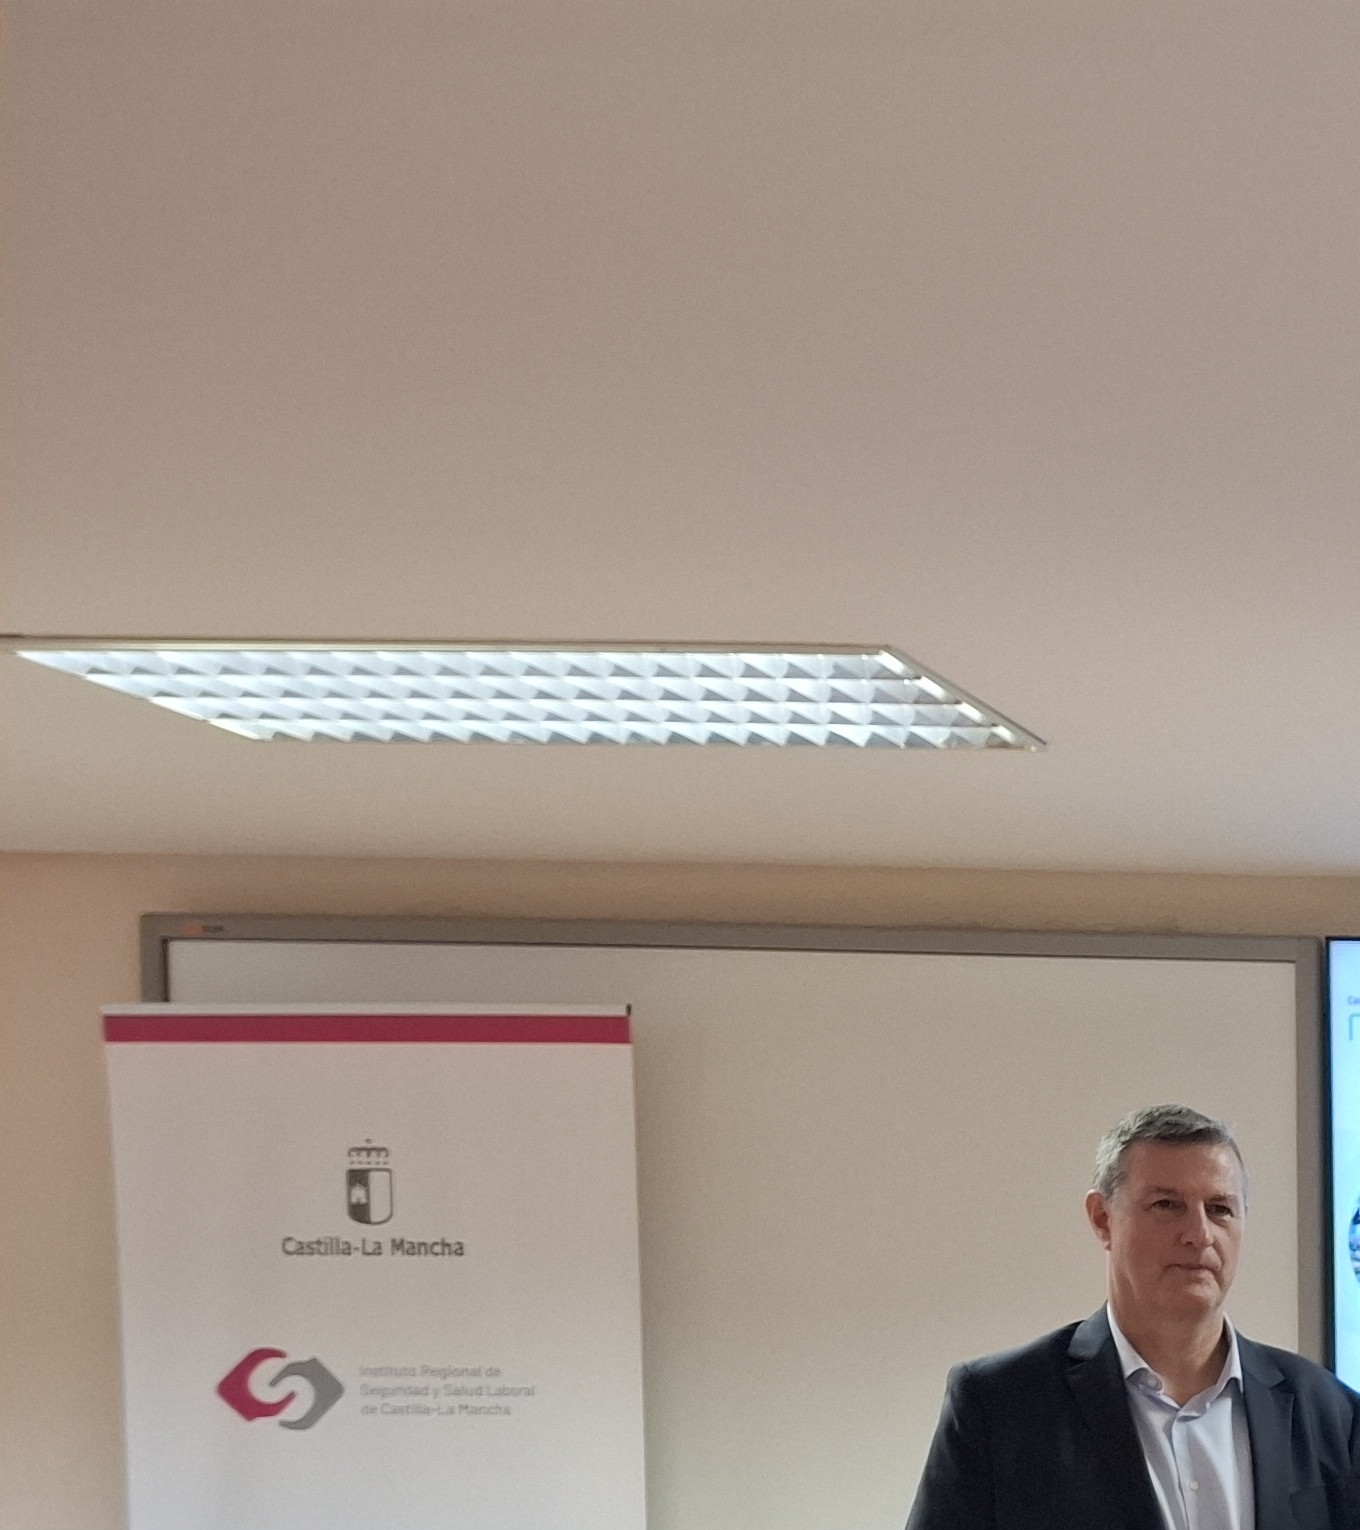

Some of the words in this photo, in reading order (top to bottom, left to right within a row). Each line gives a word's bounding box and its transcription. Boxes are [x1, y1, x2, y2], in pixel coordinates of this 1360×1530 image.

[281, 1235, 384, 1257] Castilla-La
[389, 1236, 465, 1257] Mancha
[443, 1383, 483, 1397] Salud
[486, 1383, 535, 1397] Laboral
[457, 1404, 512, 1416] Mancha
